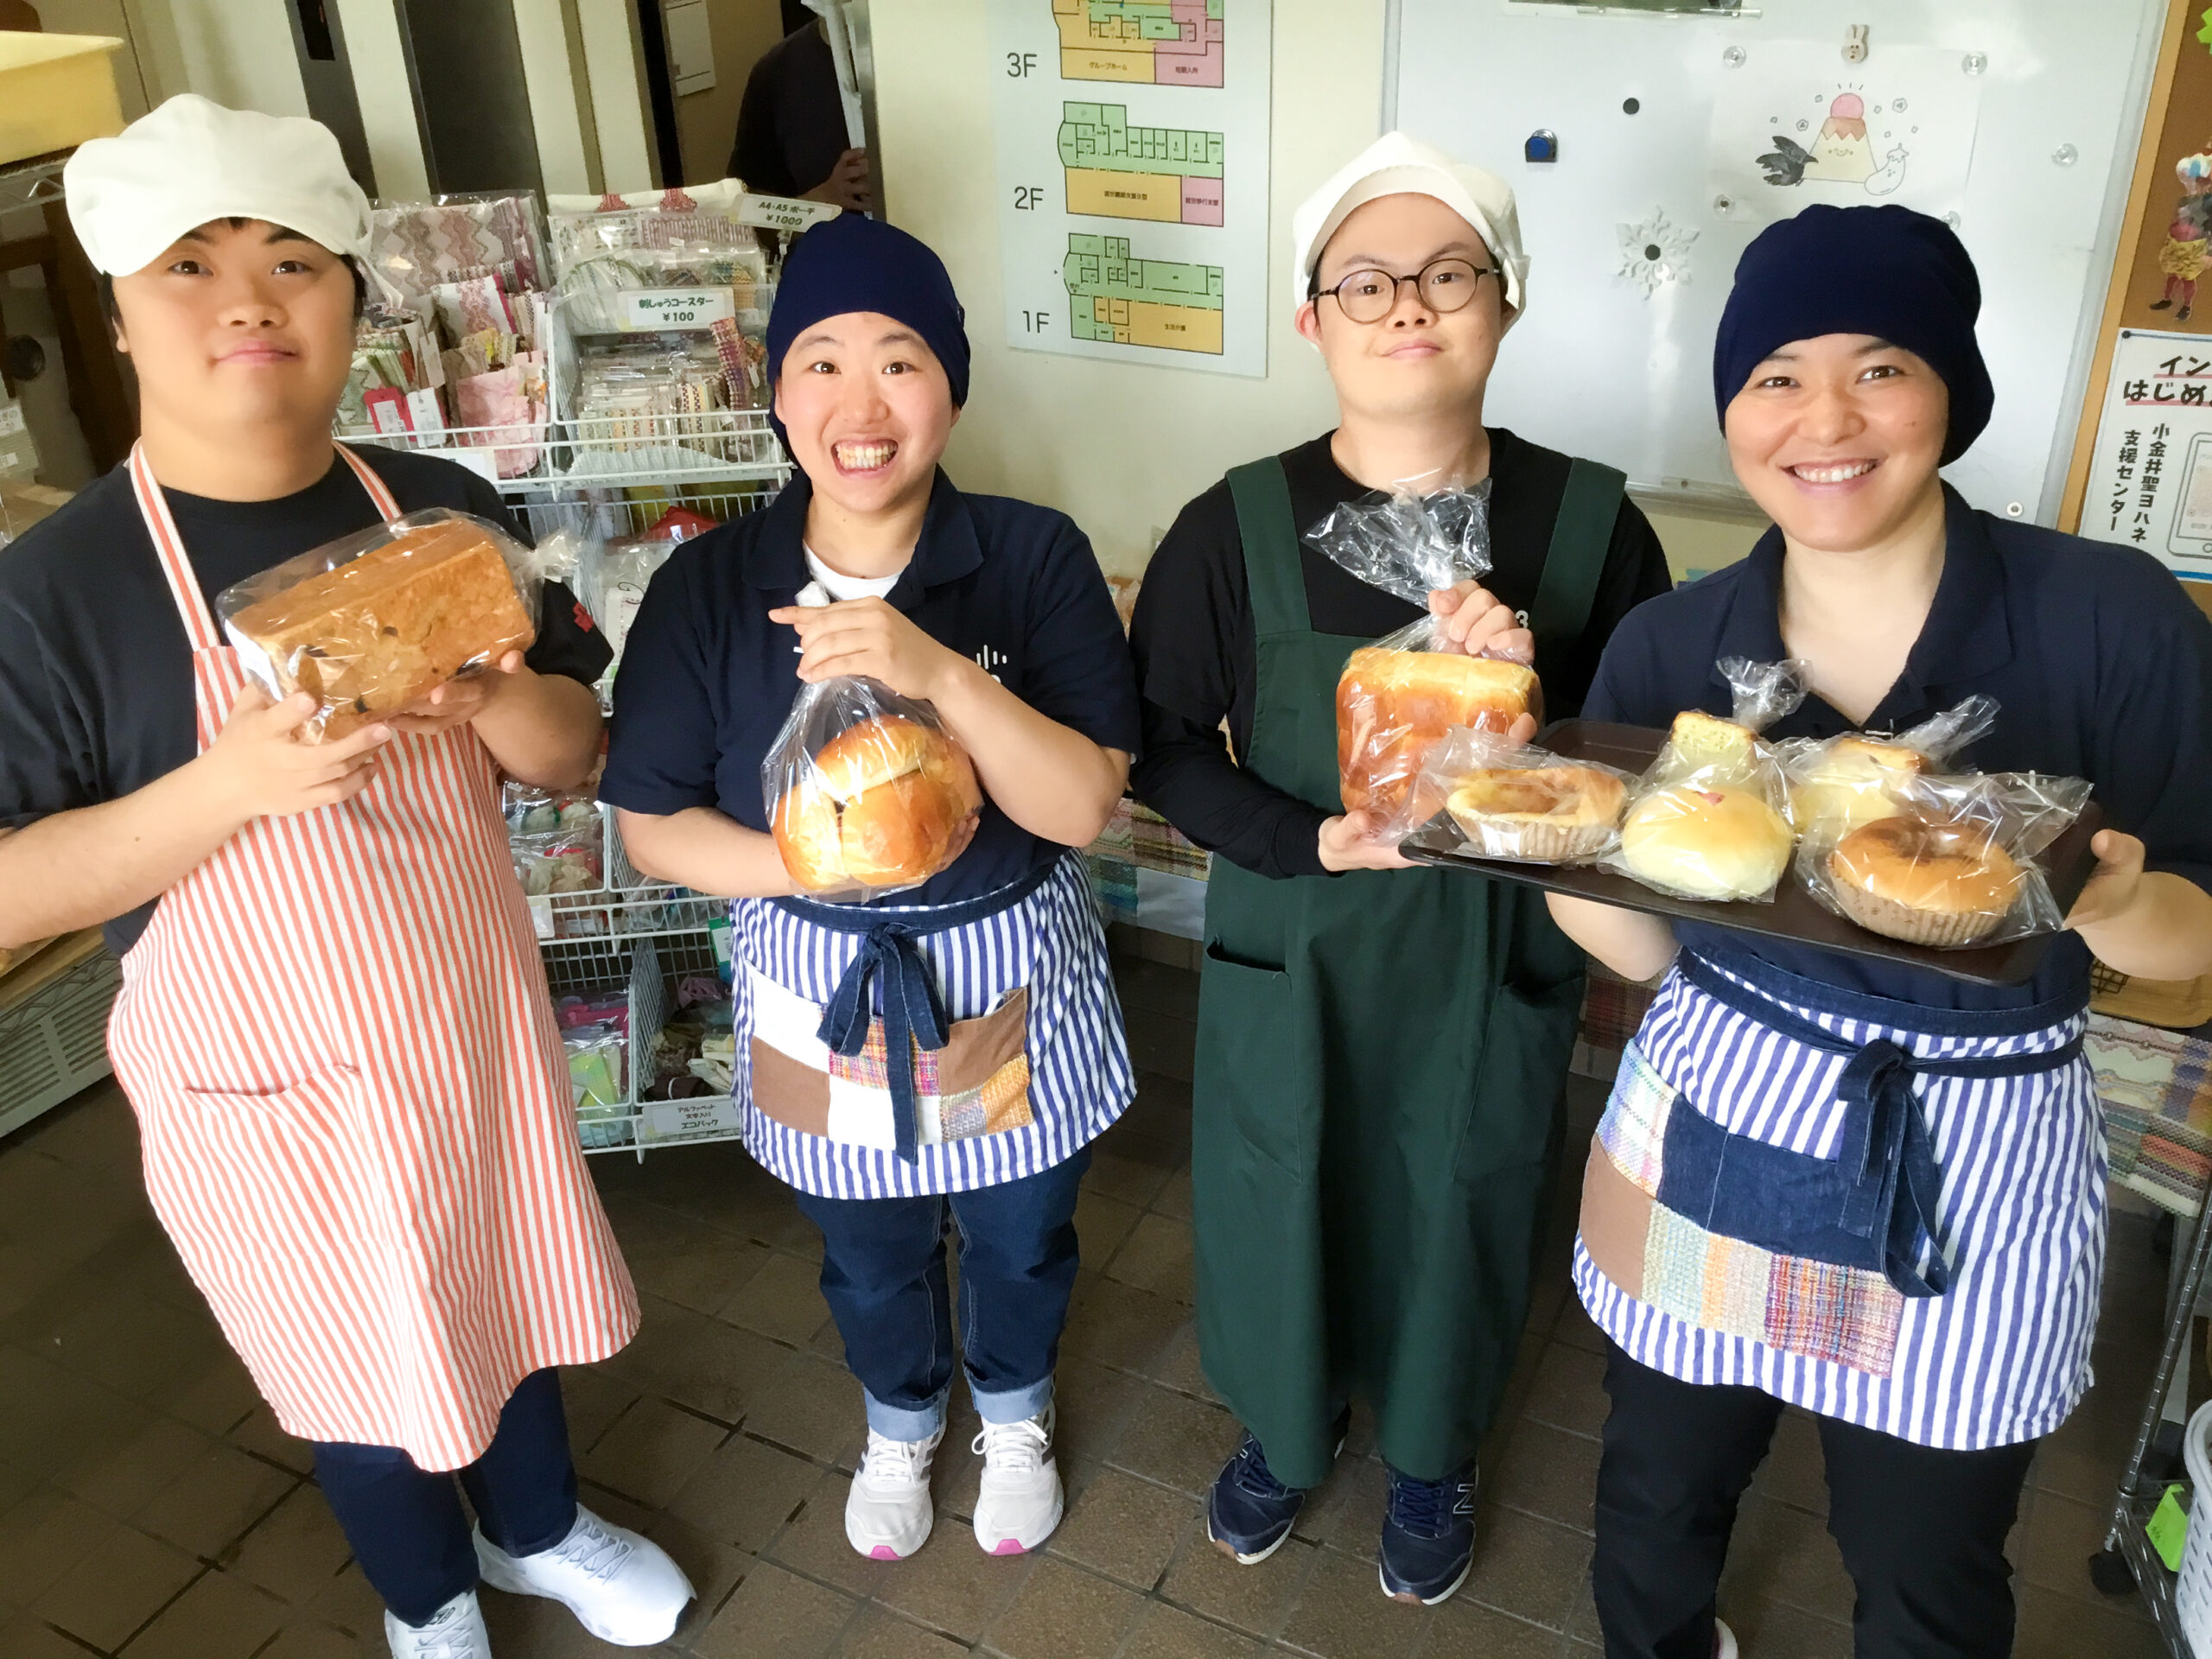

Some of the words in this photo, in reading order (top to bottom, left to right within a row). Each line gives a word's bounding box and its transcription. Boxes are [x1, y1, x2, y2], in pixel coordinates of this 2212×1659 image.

[1007, 53, 1038, 78] 3F
[1014, 186, 1044, 211] 2F
[1022, 311, 1050, 334] 1F
[2123, 379, 2212, 407] はじめ
[2110, 429, 2141, 531] 支援センター
[2131, 423, 2171, 543] 小金井聖ヨハネ
